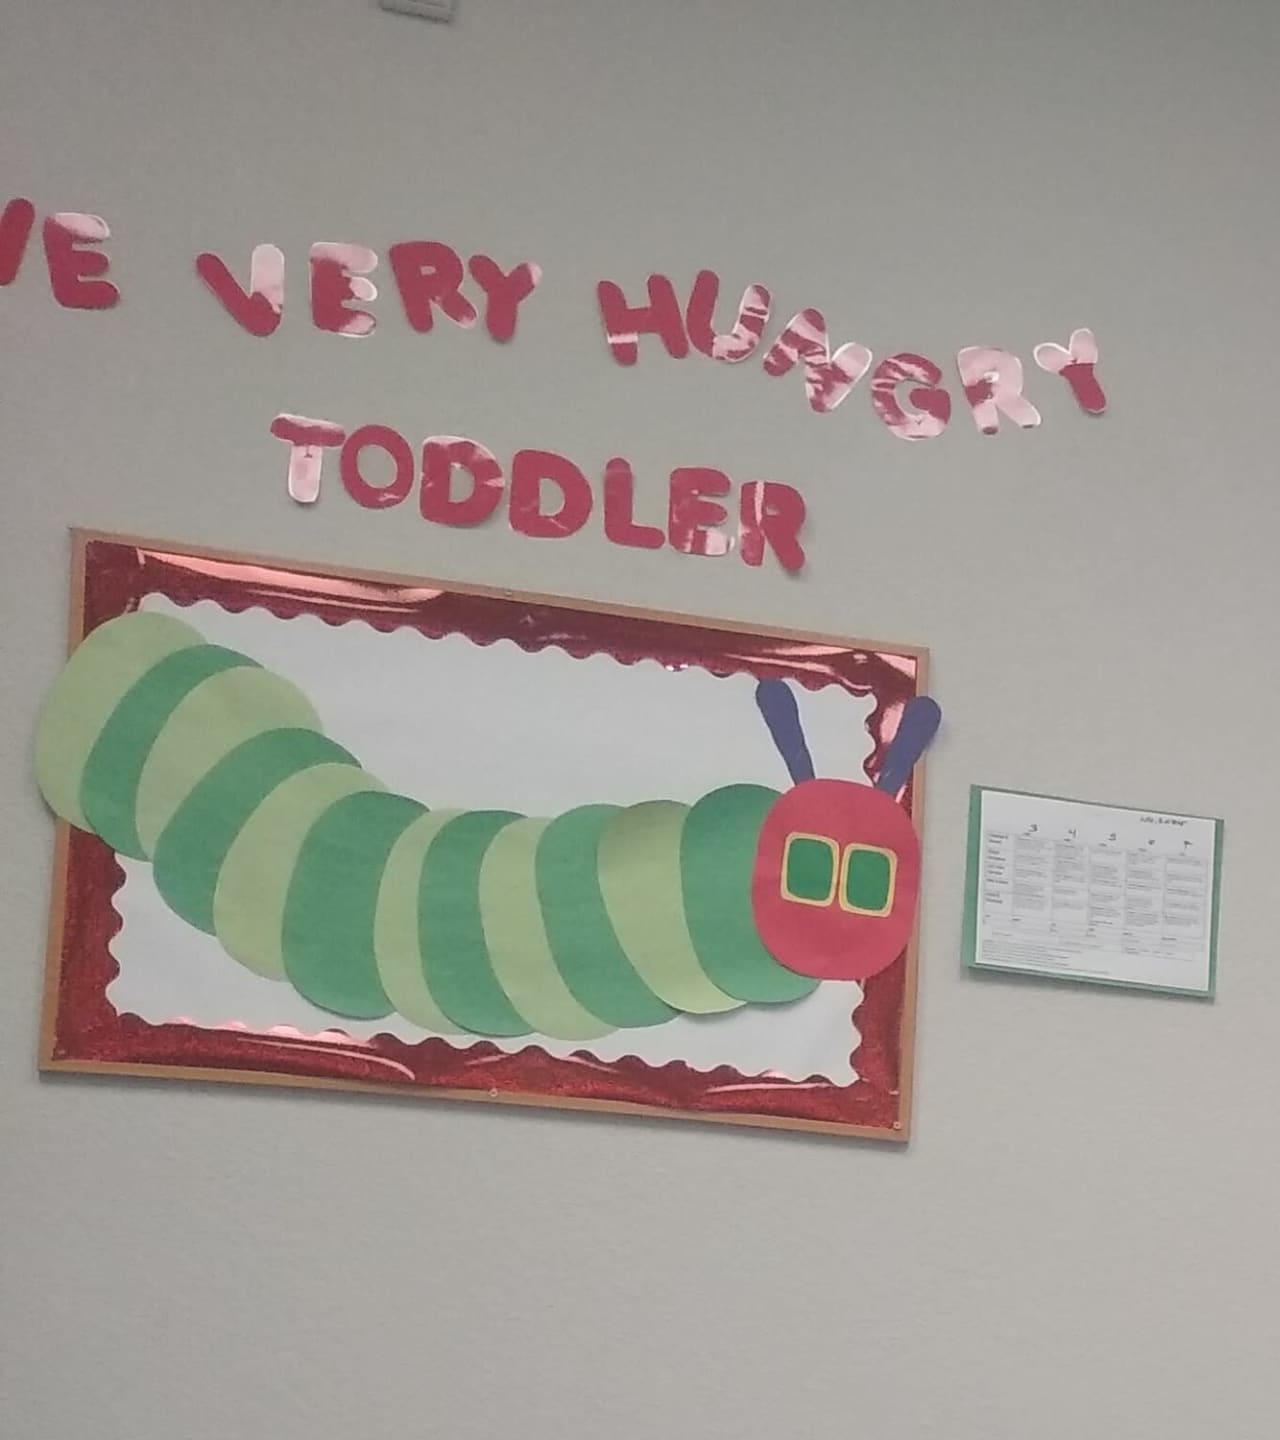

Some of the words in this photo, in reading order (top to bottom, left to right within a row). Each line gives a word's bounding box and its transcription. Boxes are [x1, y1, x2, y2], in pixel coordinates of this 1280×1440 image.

[196, 240, 542, 341] VERY
[598, 269, 1107, 440] HUNGRY
[271, 412, 807, 572] TODDLER
